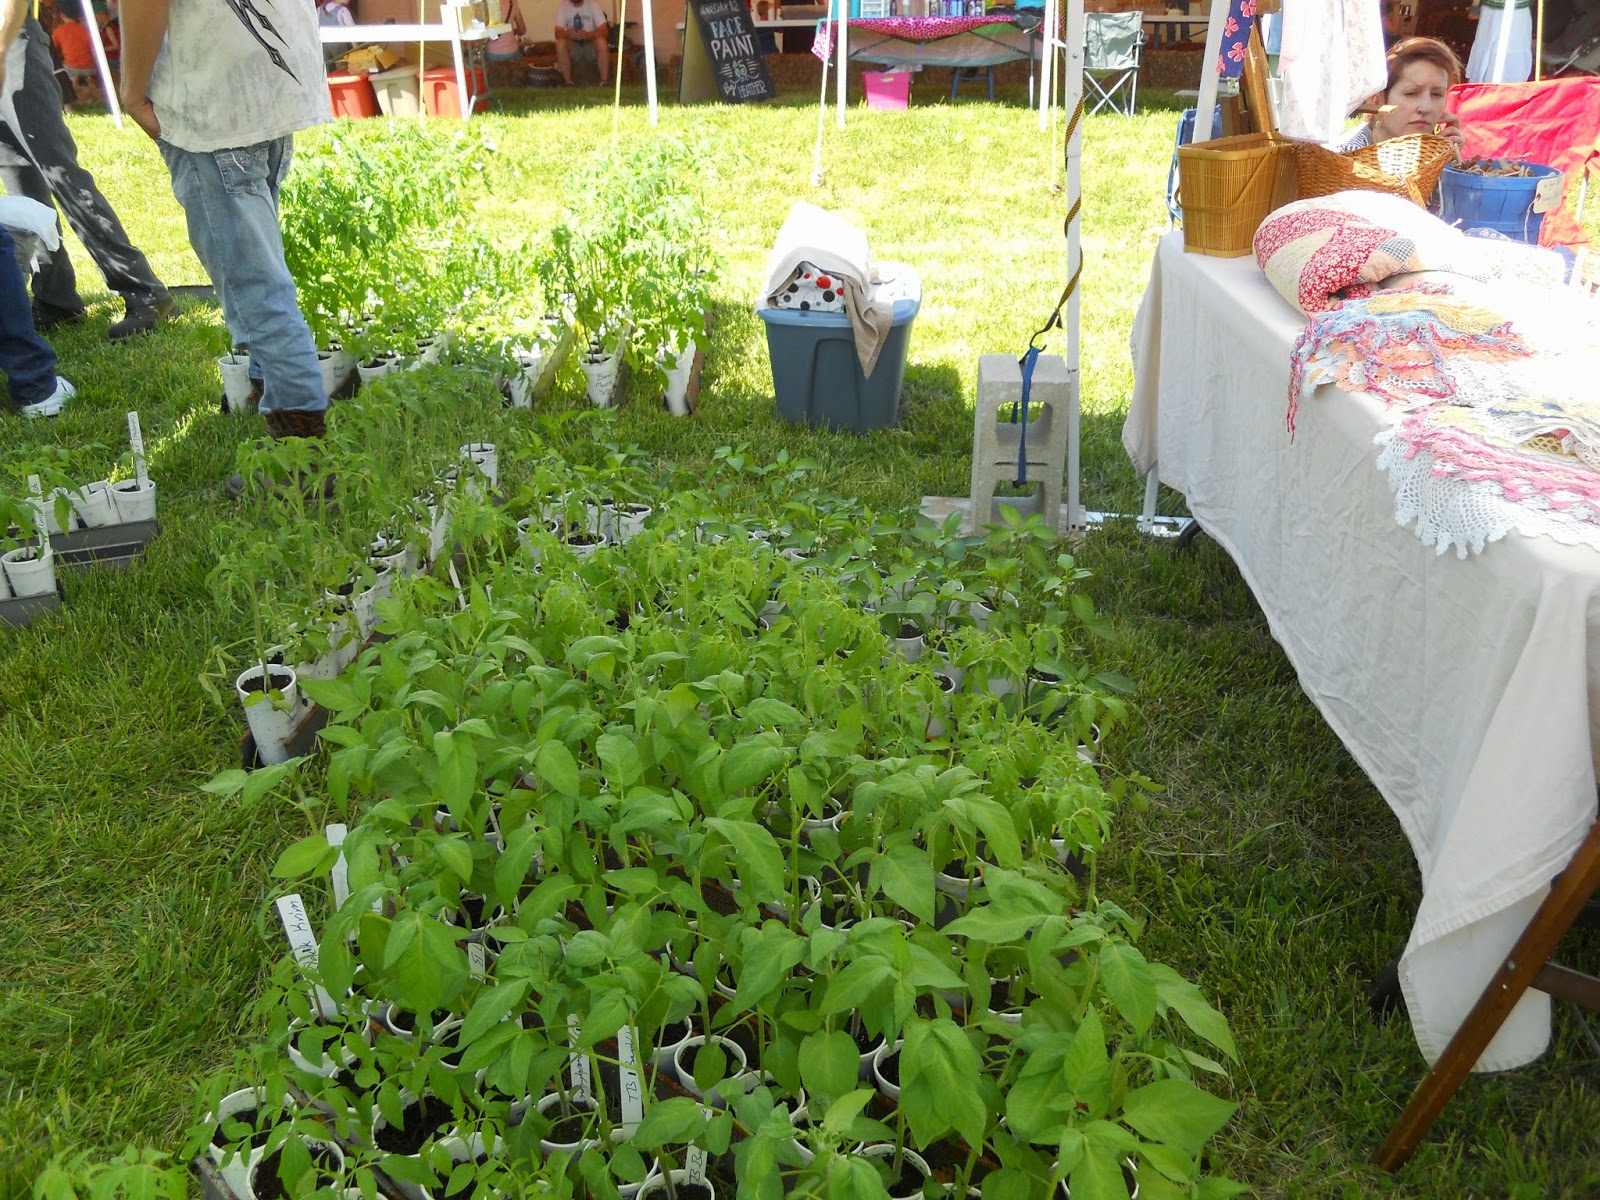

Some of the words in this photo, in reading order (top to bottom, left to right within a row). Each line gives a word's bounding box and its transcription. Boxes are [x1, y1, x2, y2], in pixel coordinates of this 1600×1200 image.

[710, 16, 745, 38] FACE
[710, 34, 754, 60] PAINT
[732, 60, 747, 77] $5
[738, 80, 767, 98] HEATHER
[290, 900, 308, 932] Krim
[625, 1081, 638, 1102] TB
